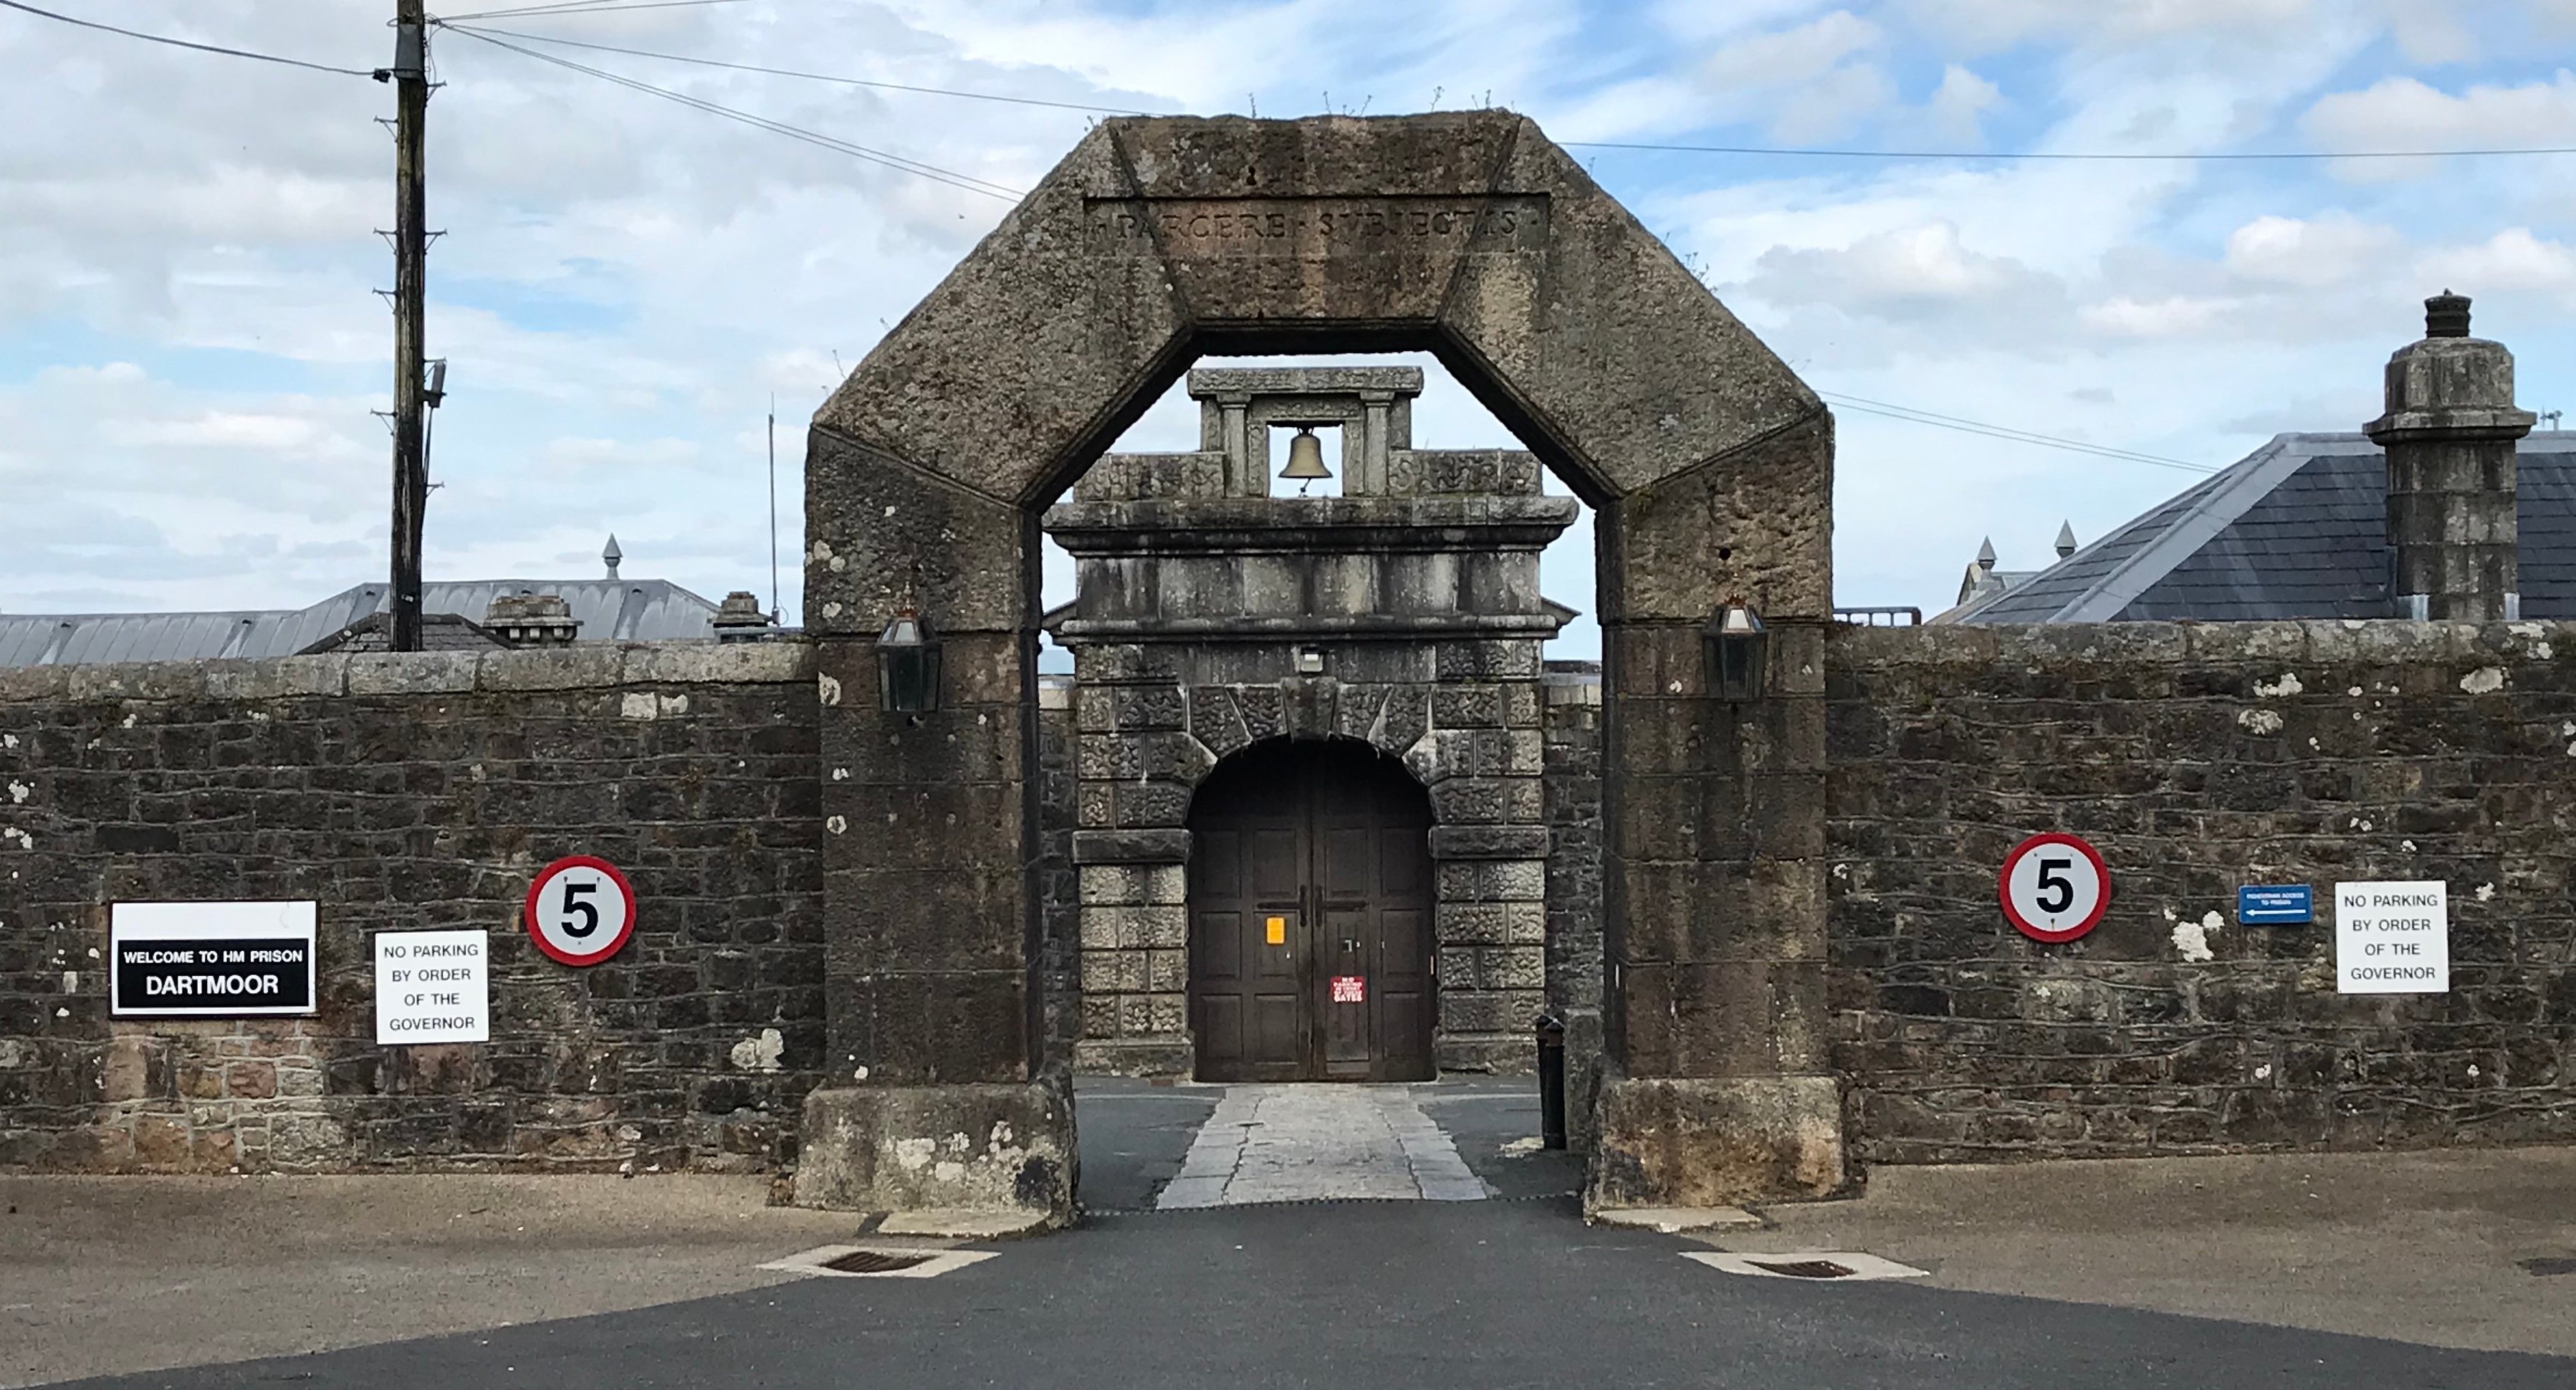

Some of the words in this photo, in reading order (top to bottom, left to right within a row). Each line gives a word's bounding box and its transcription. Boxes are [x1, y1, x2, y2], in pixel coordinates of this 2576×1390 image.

[2036, 859, 2074, 913] 5
[2345, 895, 2366, 907] NO
[2373, 894, 2438, 907] PARKING
[561, 883, 598, 938] 5
[2352, 919, 2371, 931] BY
[2379, 919, 2431, 931] ORDER
[384, 946, 406, 958] NO
[413, 944, 479, 957] PARKING
[2365, 944, 2385, 956] OF
[2392, 943, 2421, 955] THE
[123, 951, 193, 964] WELCOME
[199, 951, 218, 963] TO
[223, 950, 245, 963] HM
[250, 949, 302, 962] PRISON
[392, 970, 411, 982] BY
[418, 969, 471, 982] ORDER
[2351, 967, 2436, 980] GOVERNOR
[146, 974, 279, 995] DARTMOOR
[404, 994, 424, 1006] OF
[431, 993, 460, 1005] THE
[390, 1017, 475, 1031] GOVERNOR
